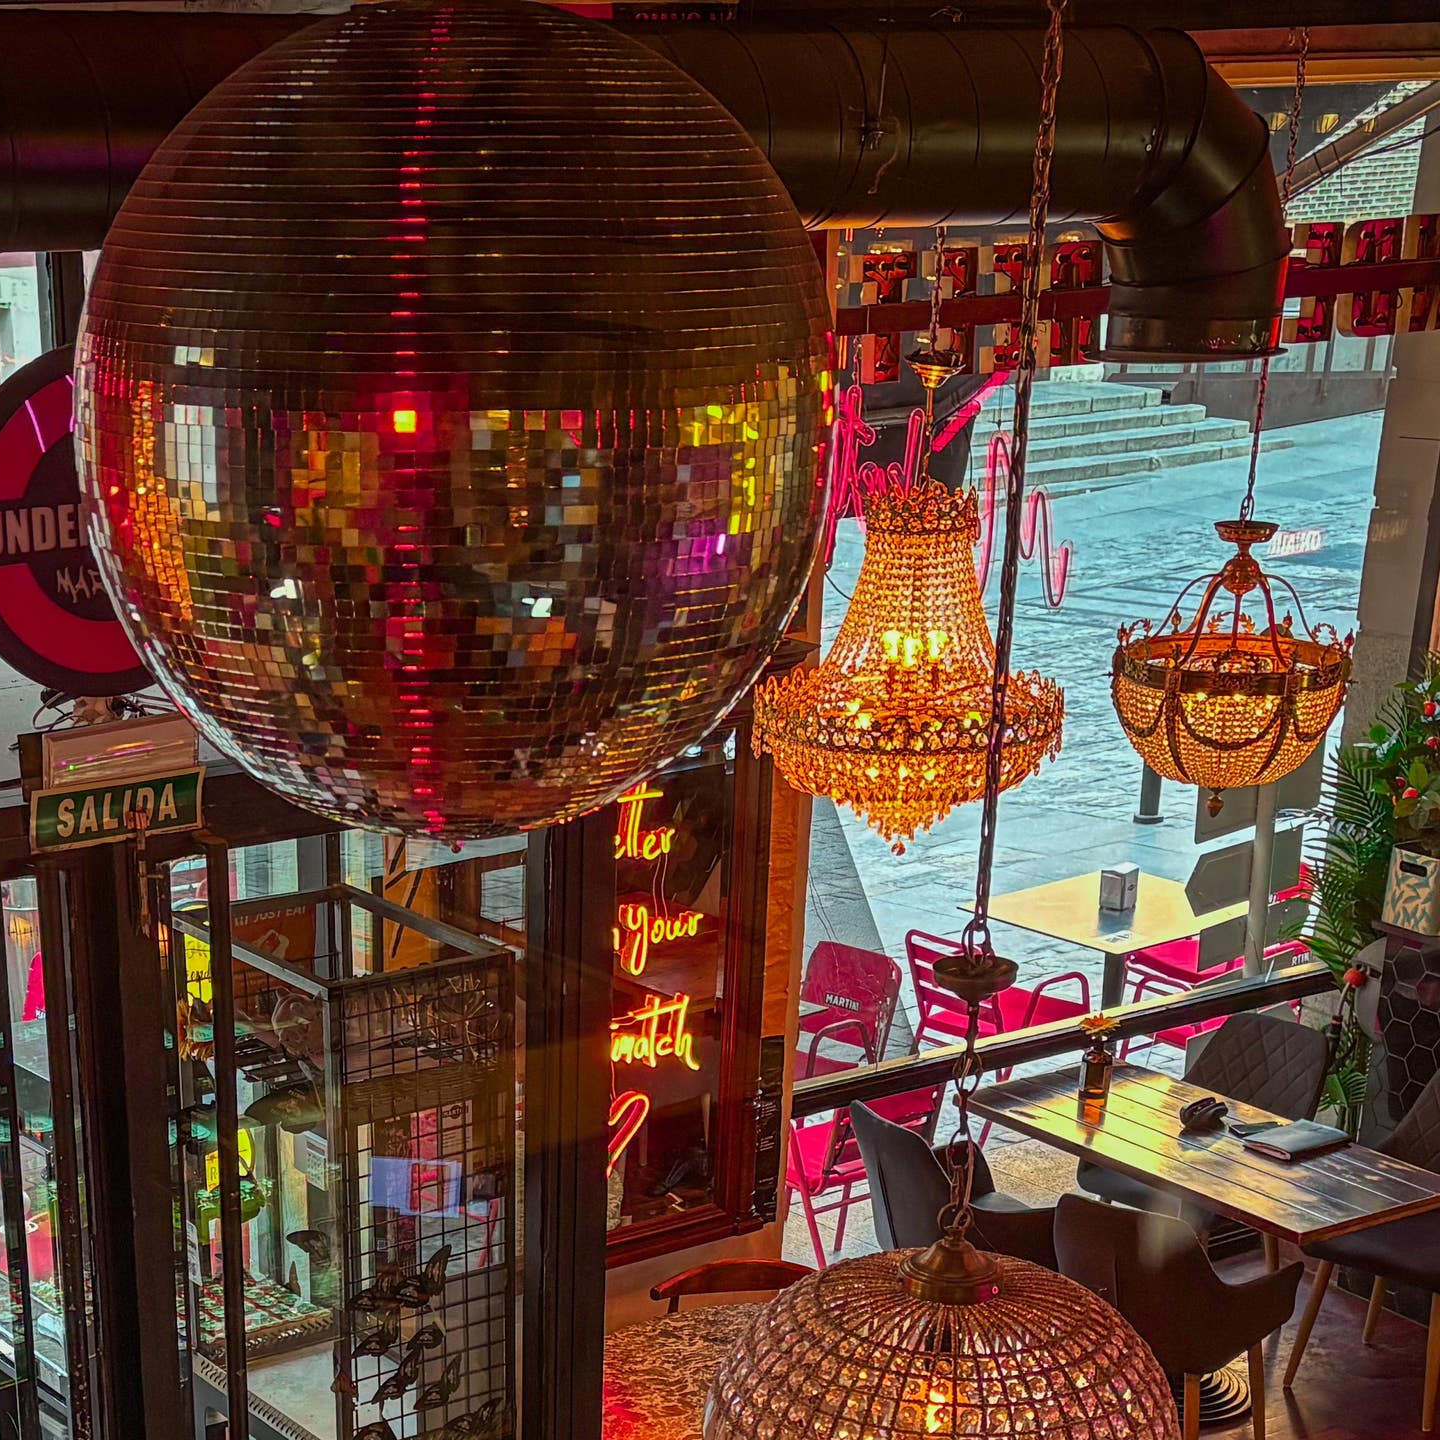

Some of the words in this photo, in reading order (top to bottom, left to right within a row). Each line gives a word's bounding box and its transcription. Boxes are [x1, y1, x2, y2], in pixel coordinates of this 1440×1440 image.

[56, 782, 178, 838] SALIDA
[627, 905, 704, 976] your
[825, 993, 860, 1012] MARTINI
